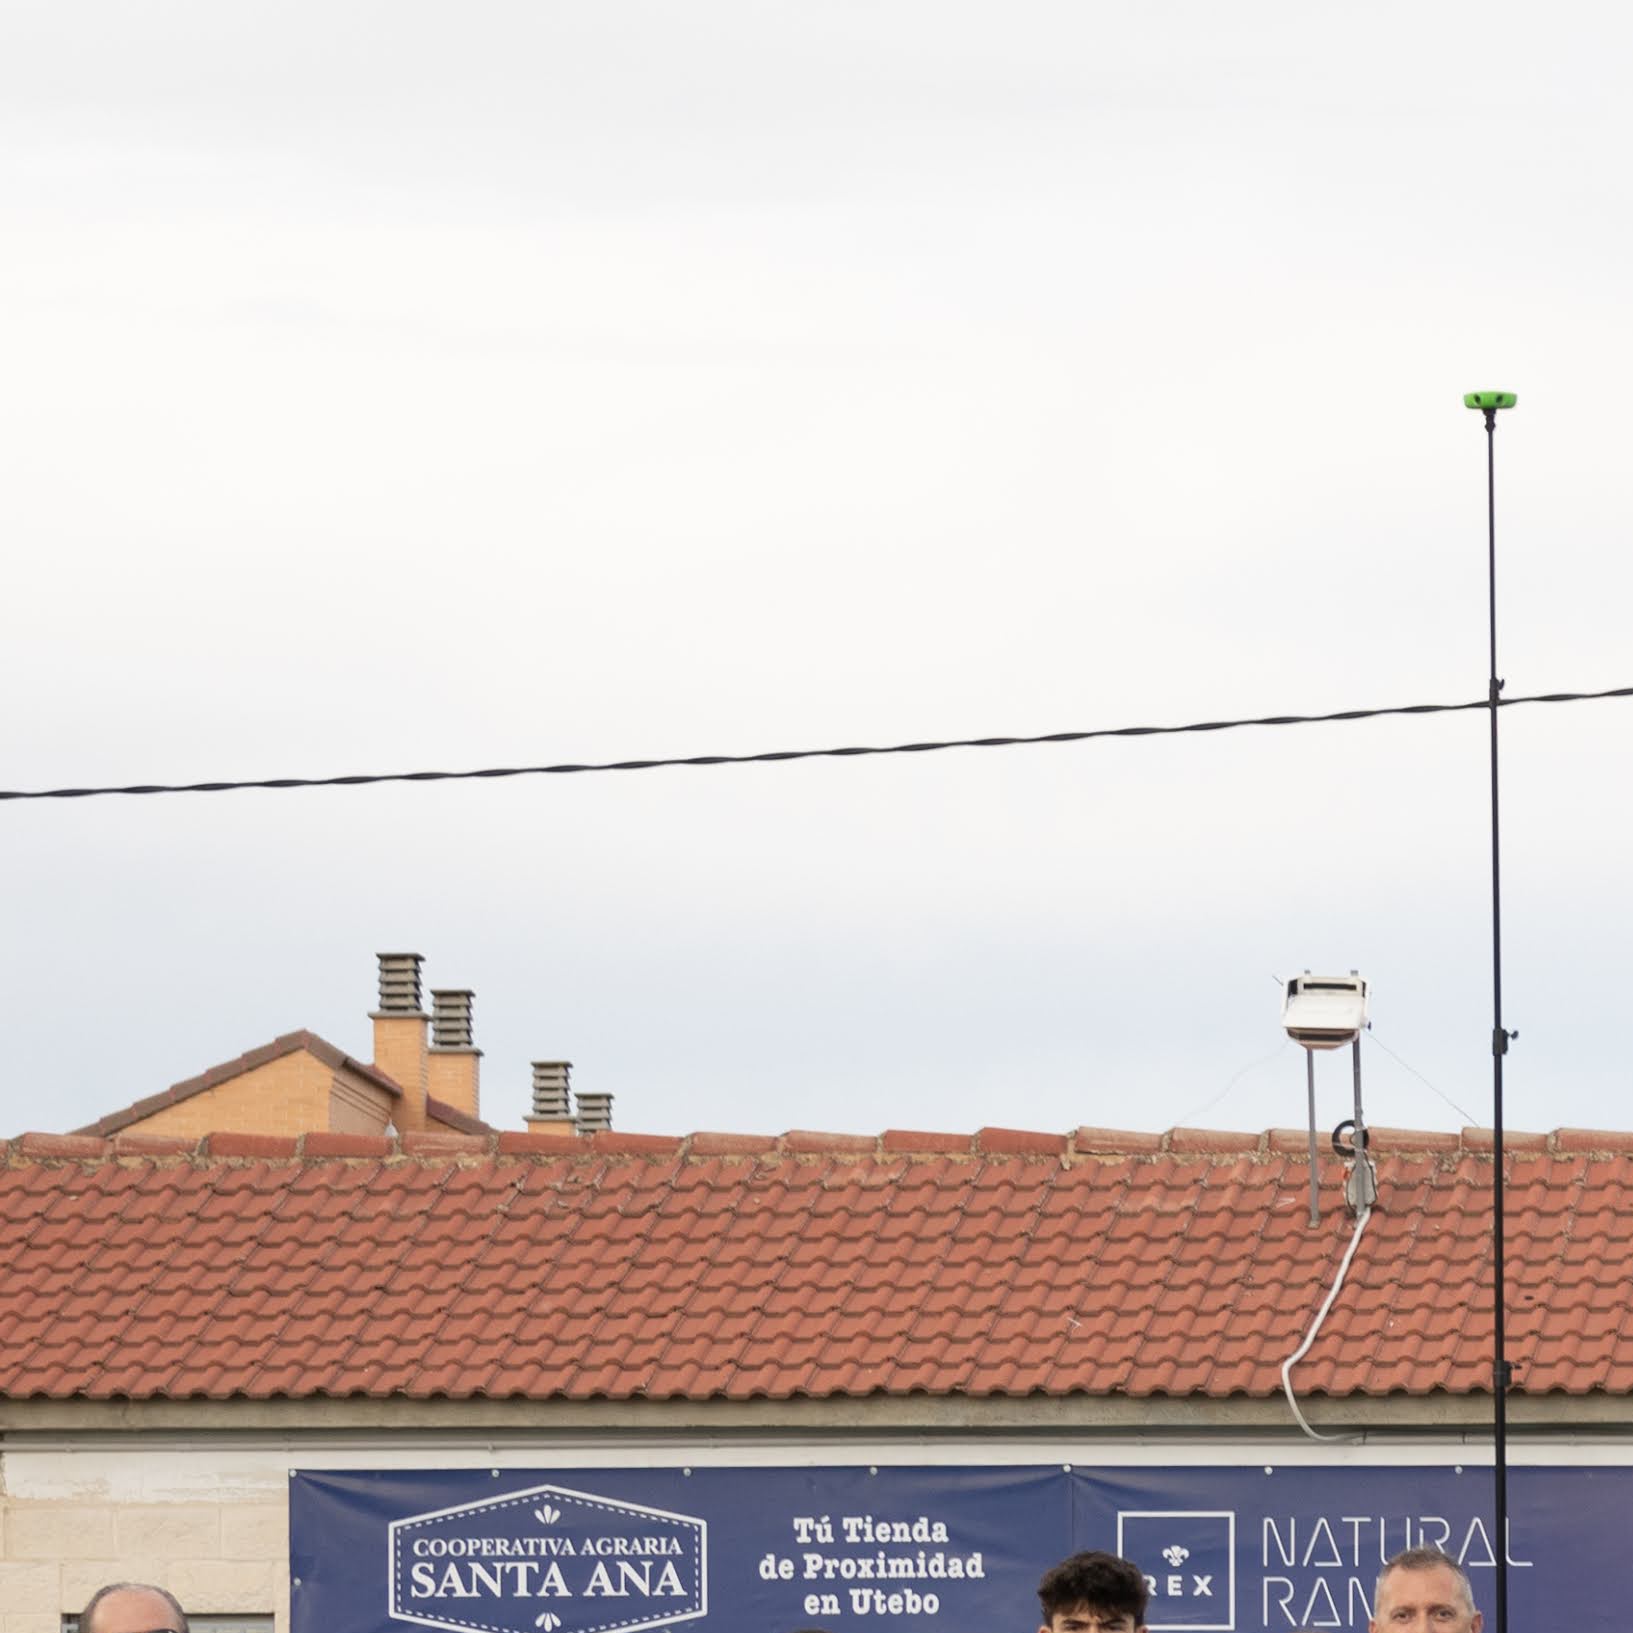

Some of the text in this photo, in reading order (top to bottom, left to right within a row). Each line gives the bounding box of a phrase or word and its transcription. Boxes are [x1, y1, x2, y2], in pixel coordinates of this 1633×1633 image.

[794, 1516, 949, 1544] Tú Tienda
[1263, 1516, 1533, 1567] NATURAL
[413, 1536, 684, 1557] COOPERATIVA AGRARIA
[410, 1560, 688, 1598] SANTA ANA
[759, 1552, 985, 1581] de Proximidad
[804, 1589, 940, 1615] en Utebo
